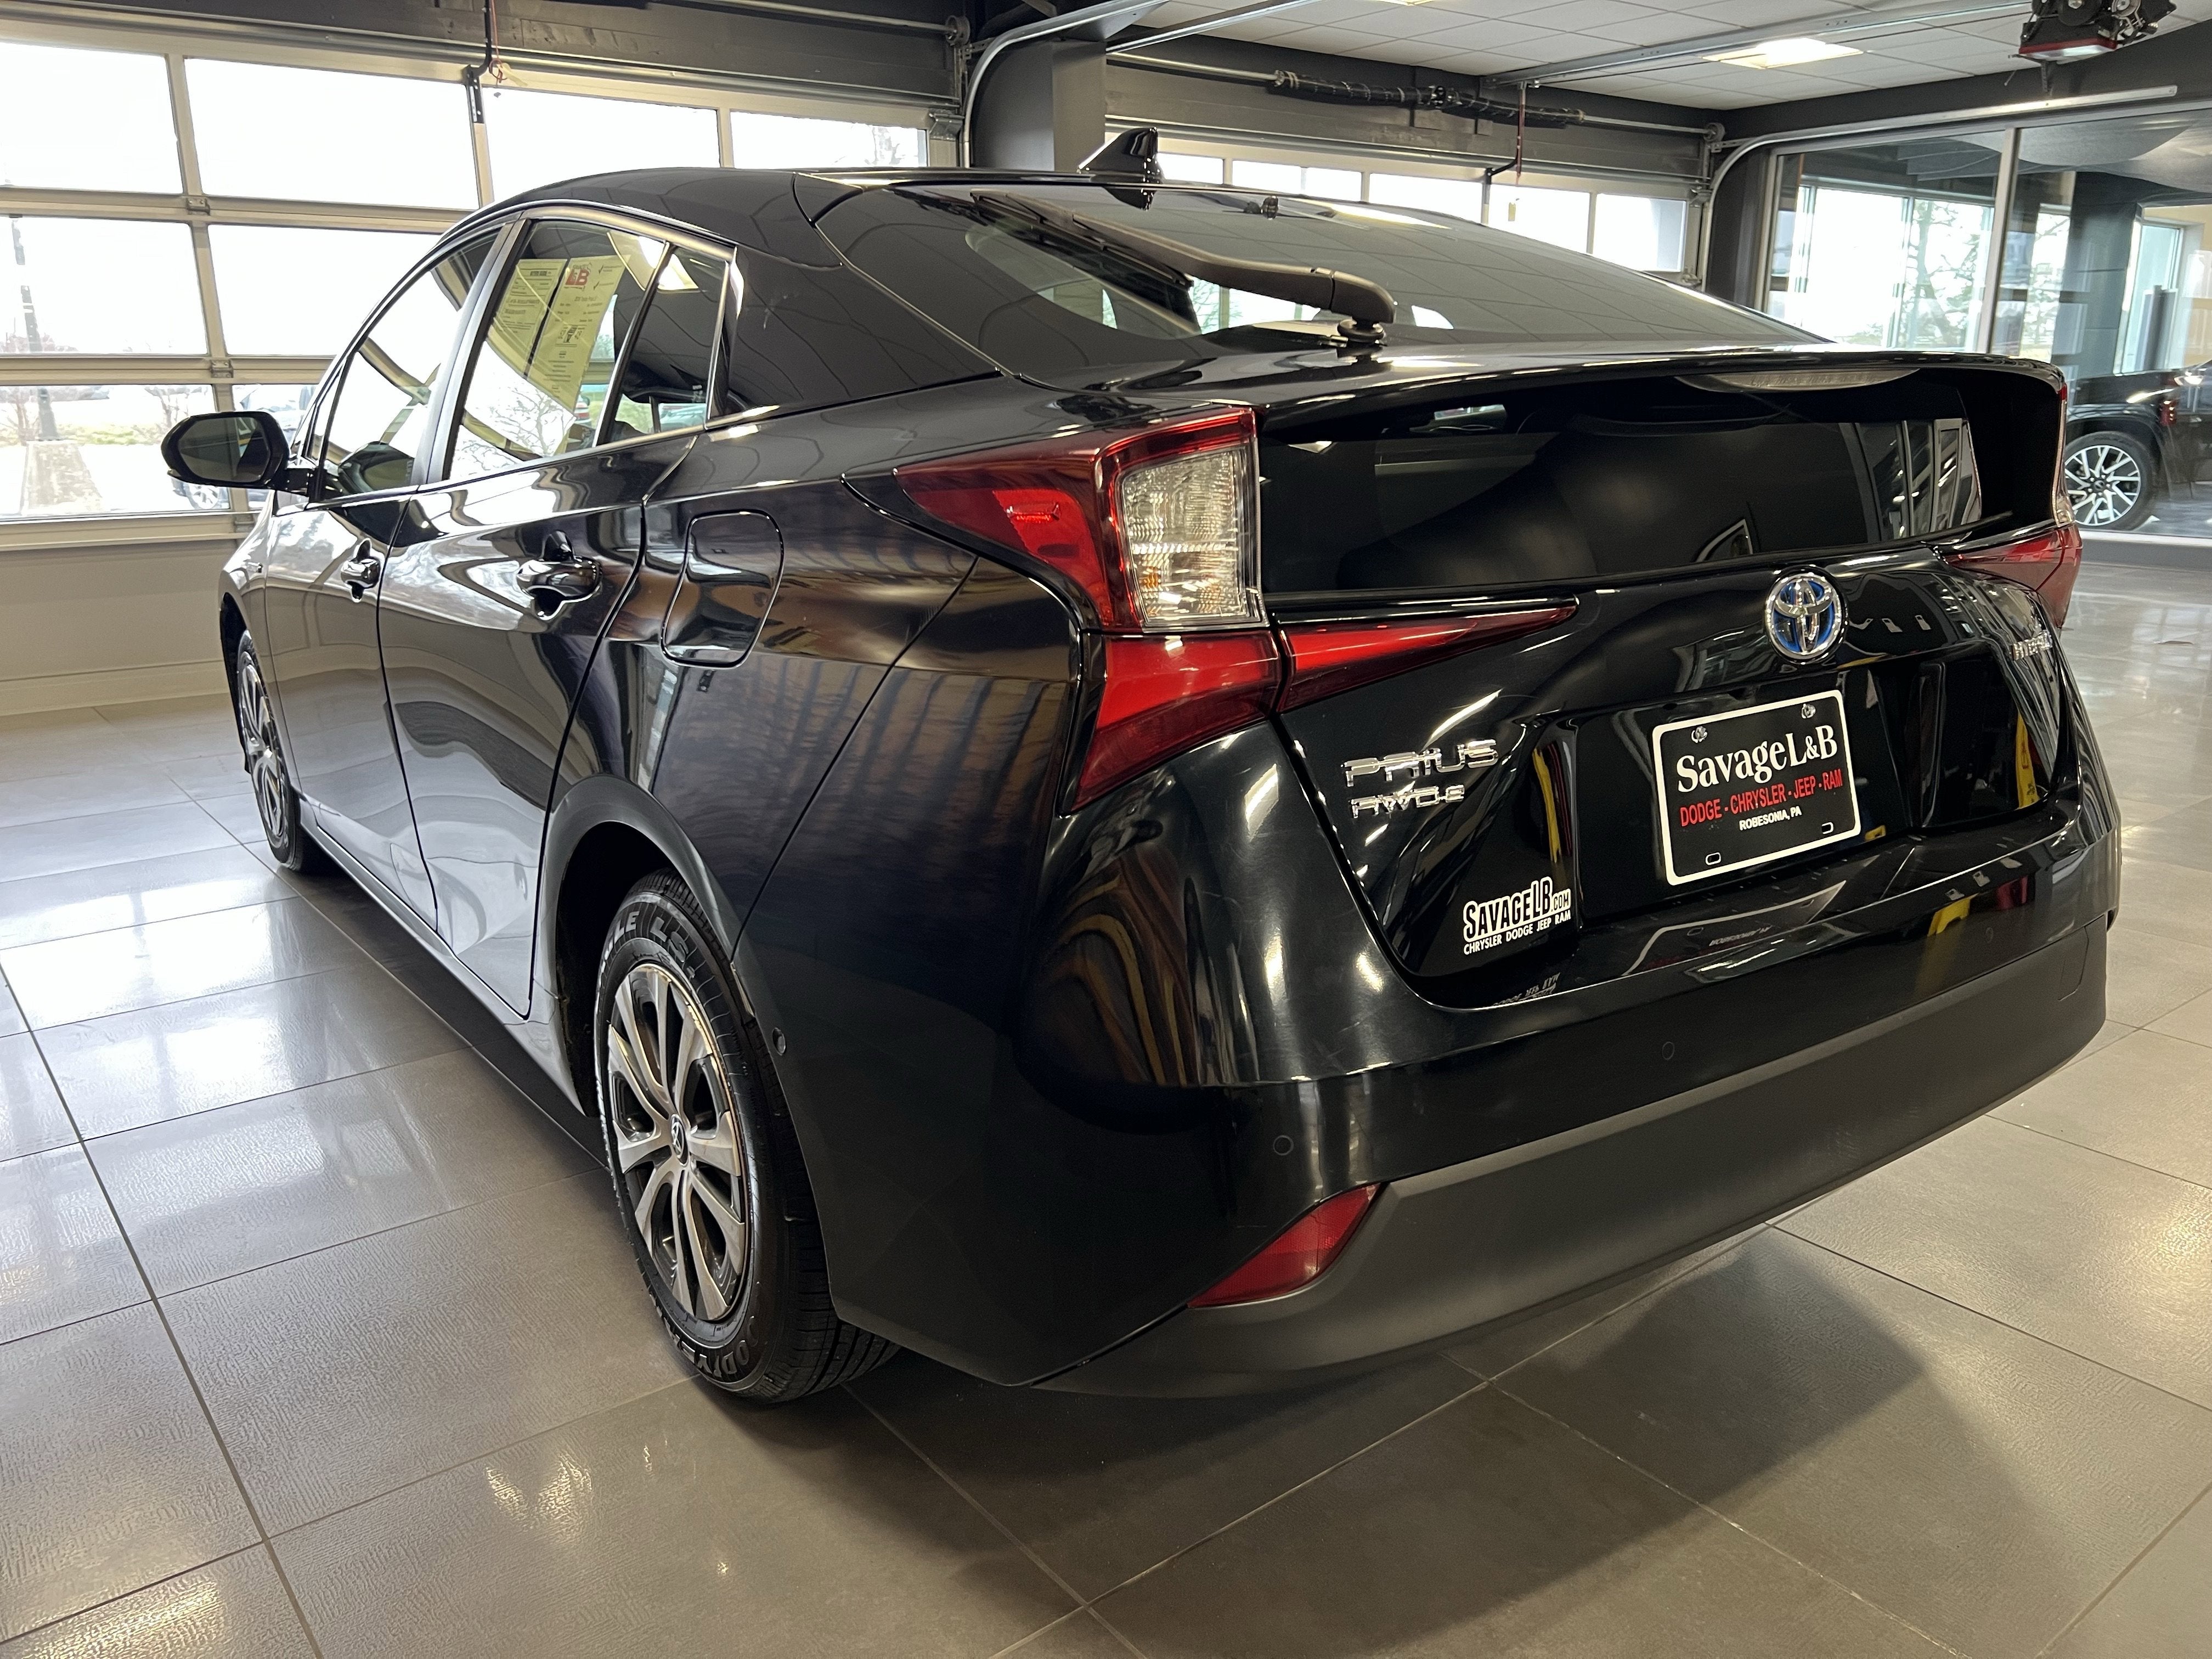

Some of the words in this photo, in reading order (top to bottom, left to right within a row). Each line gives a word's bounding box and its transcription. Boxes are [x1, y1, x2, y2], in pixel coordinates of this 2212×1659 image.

[1341, 738, 1499, 787] PRIUS
[1680, 799, 1722, 827] DODGE
[1730, 783, 1786, 814] CHRYSLER
[1793, 776, 1816, 799] JEEP
[1822, 769, 1843, 791] RAM
[1739, 809, 1790, 831] ROBESONIA,
[1790, 806, 1802, 819] PA
[1464, 934, 1502, 955] CHRYSLER
[1506, 924, 1533, 942] DODGE
[1536, 917, 1552, 932] JEEP
[1555, 910, 1571, 925] RAM
